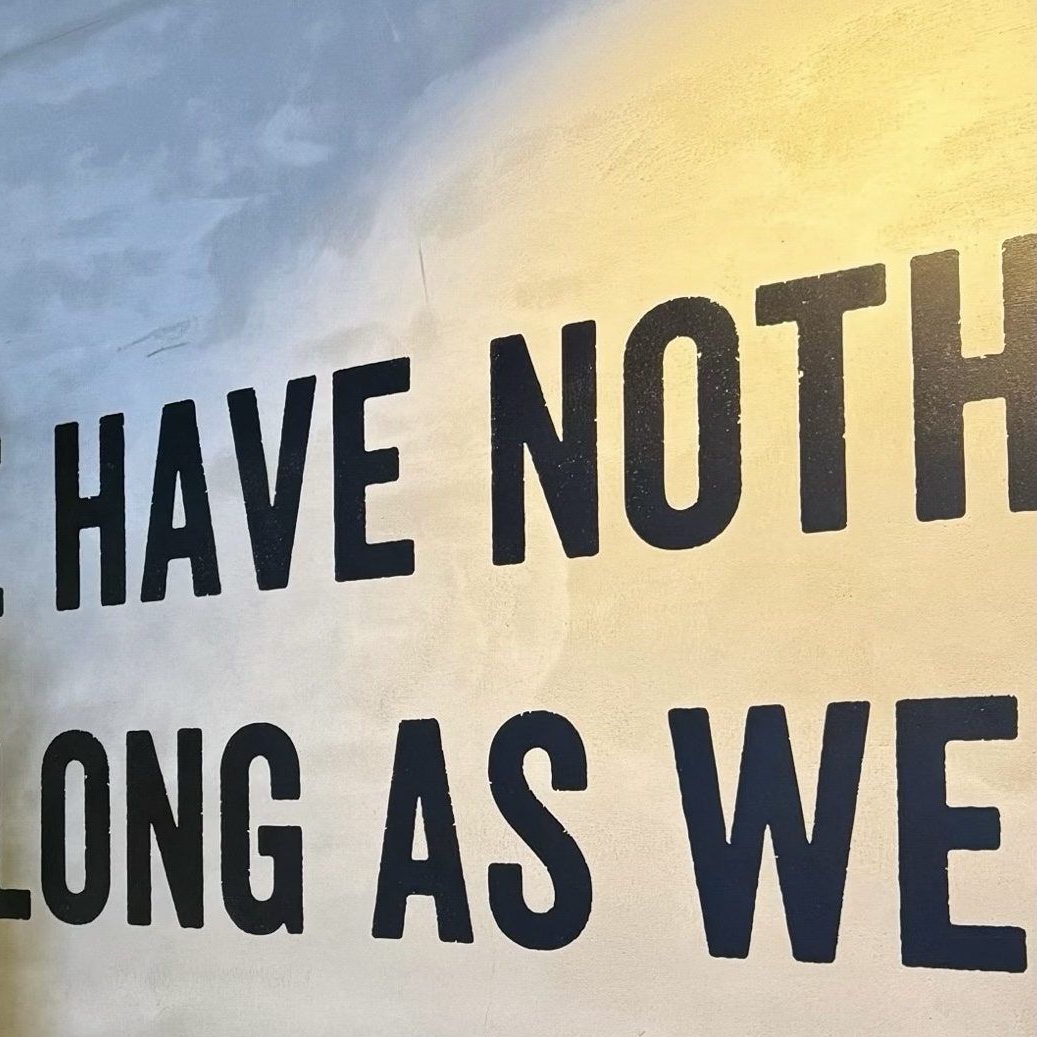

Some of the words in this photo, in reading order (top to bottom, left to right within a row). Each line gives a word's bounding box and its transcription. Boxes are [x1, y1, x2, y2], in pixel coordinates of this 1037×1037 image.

[55, 357, 414, 610] HAVE
[490, 233, 1037, 565] NOTH
[372, 710, 592, 950] AS
[668, 695, 1027, 973] WE
